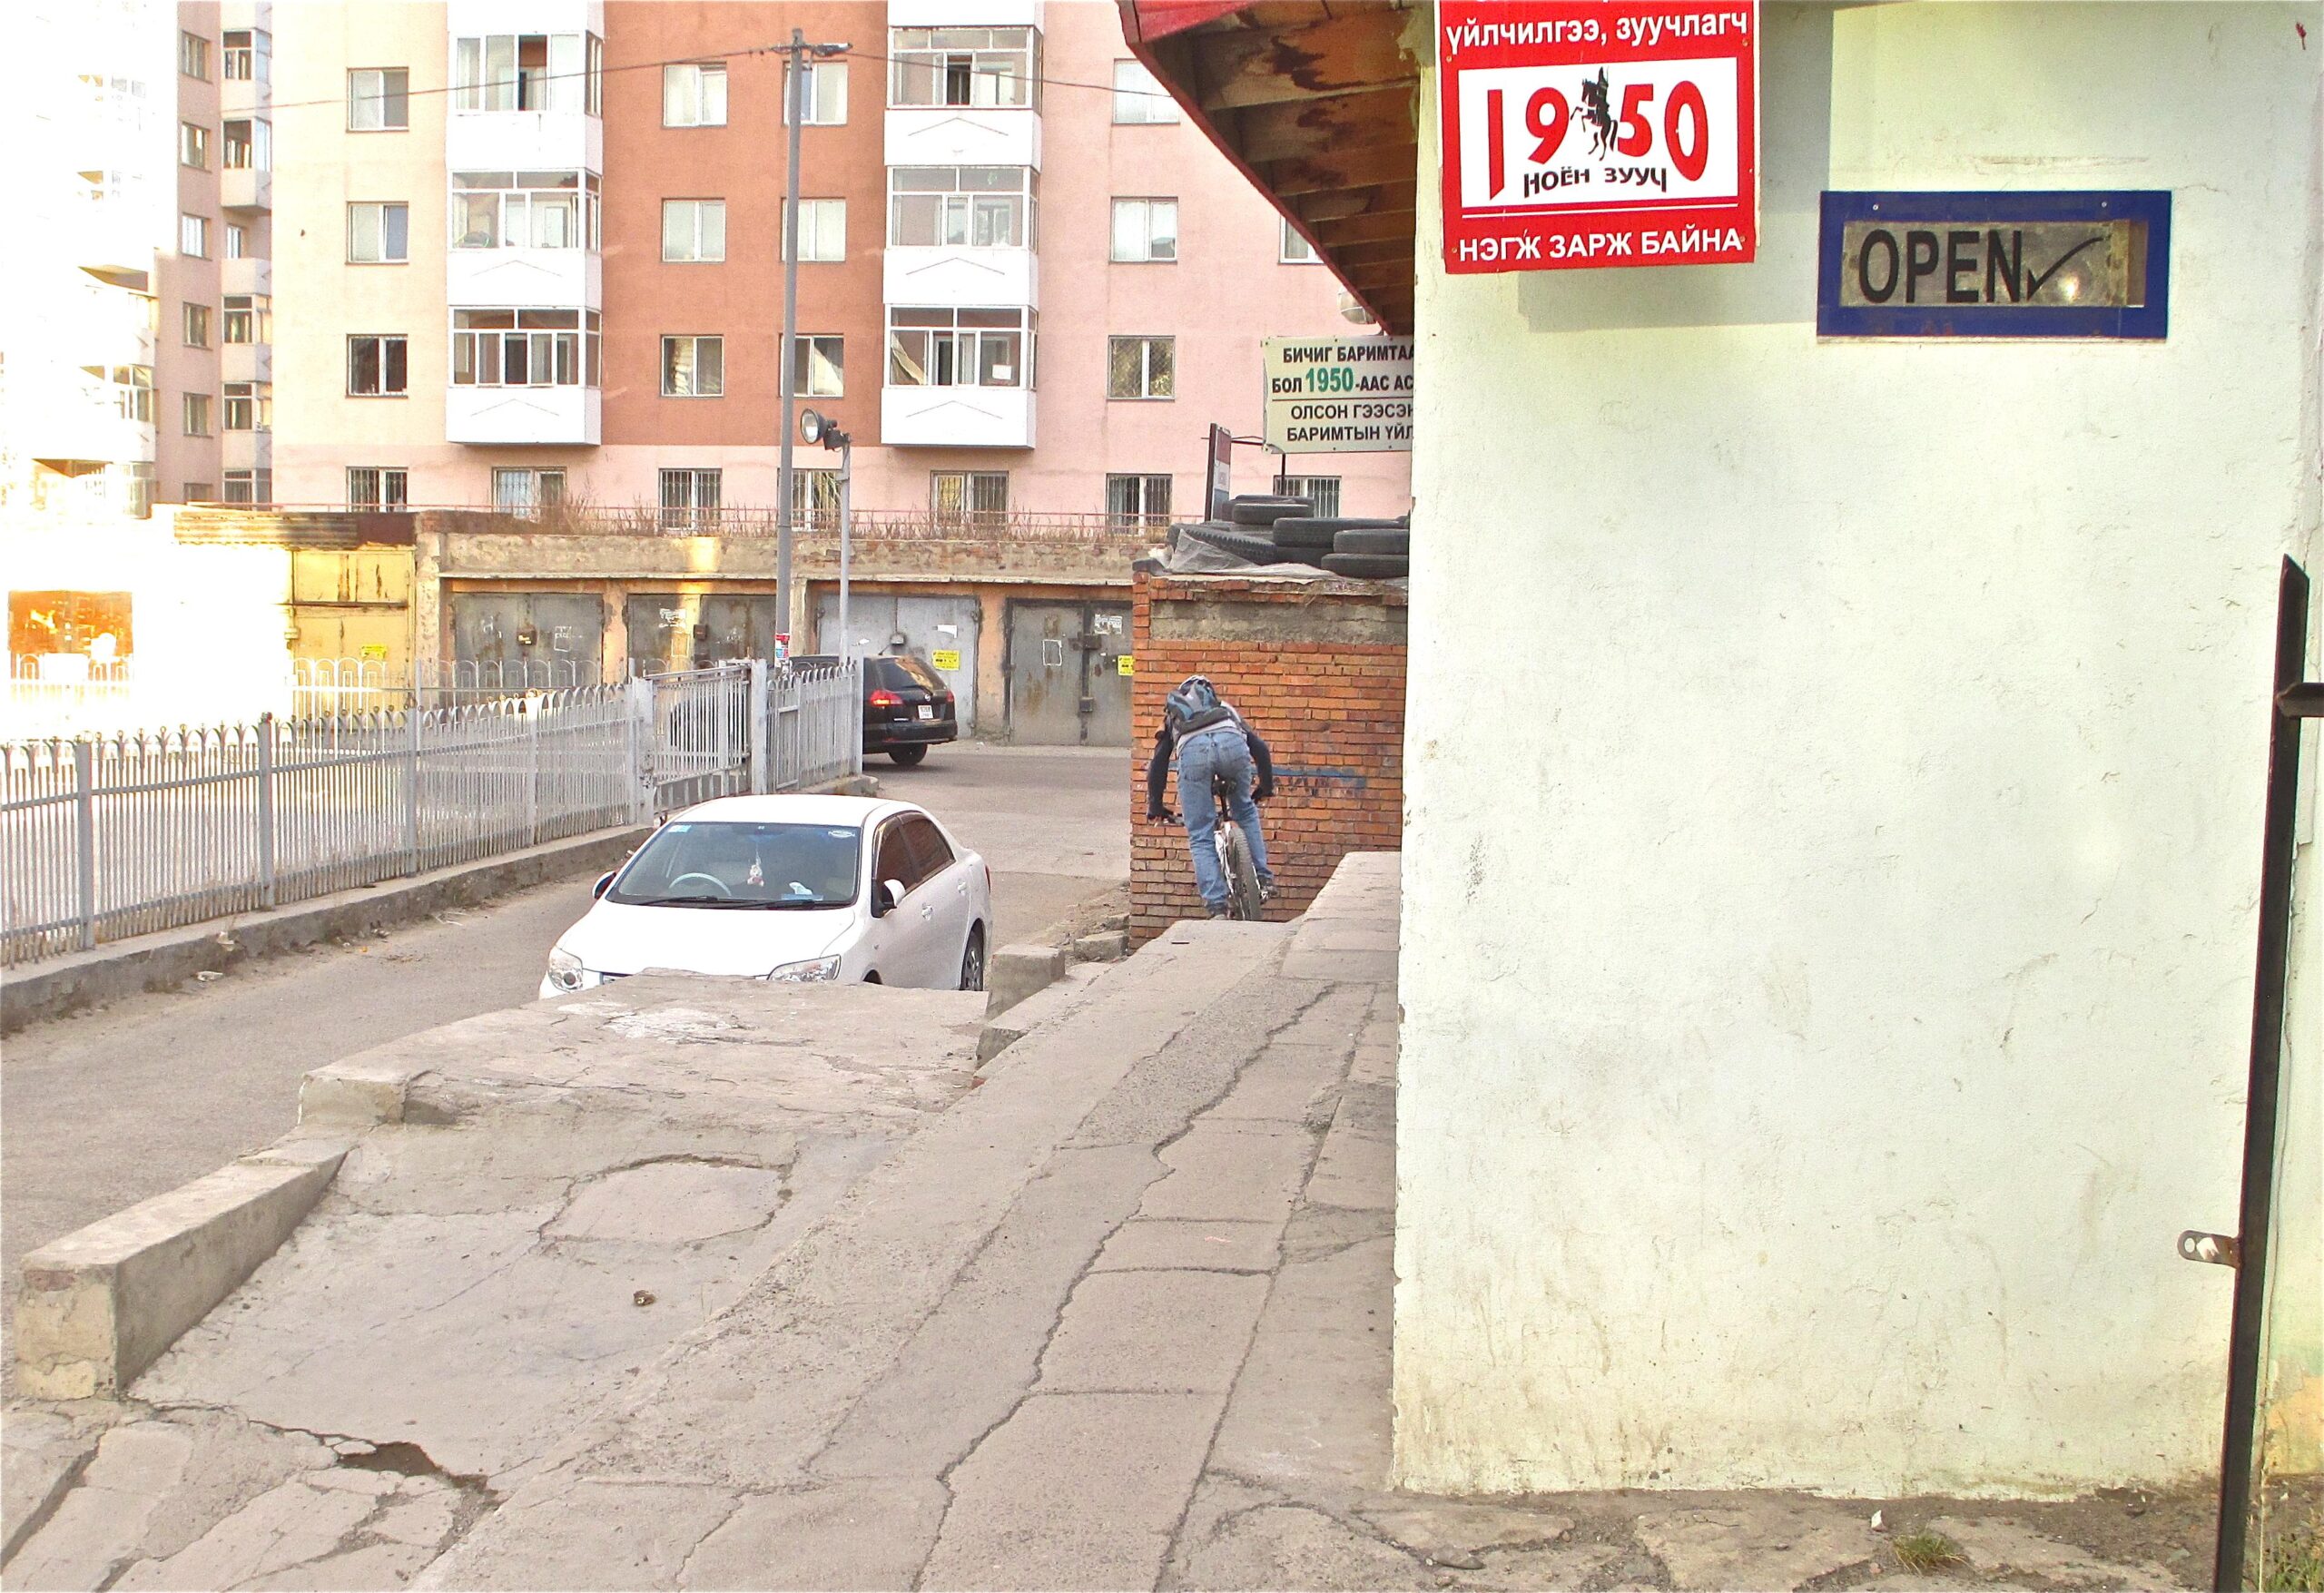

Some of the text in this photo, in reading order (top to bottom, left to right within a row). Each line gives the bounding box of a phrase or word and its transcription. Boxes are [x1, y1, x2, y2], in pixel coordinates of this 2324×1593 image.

[1445, 11, 1748, 54] үйлчилгээ, зуучлагч
[1487, 80, 1709, 200] 1950
[1523, 166, 1667, 198] НОЁН ЗУУЧ
[1460, 223, 1743, 261] НЭГЖ ЗАРЖ БАЙНА
[1858, 230, 2022, 303] OPEN
[1283, 348, 1333, 363] БИЧИГ
[1272, 378, 1302, 393] БОЛ
[1291, 405, 1347, 419] ОЛСОН
[1287, 426, 1380, 441] БАРИМТЫН
